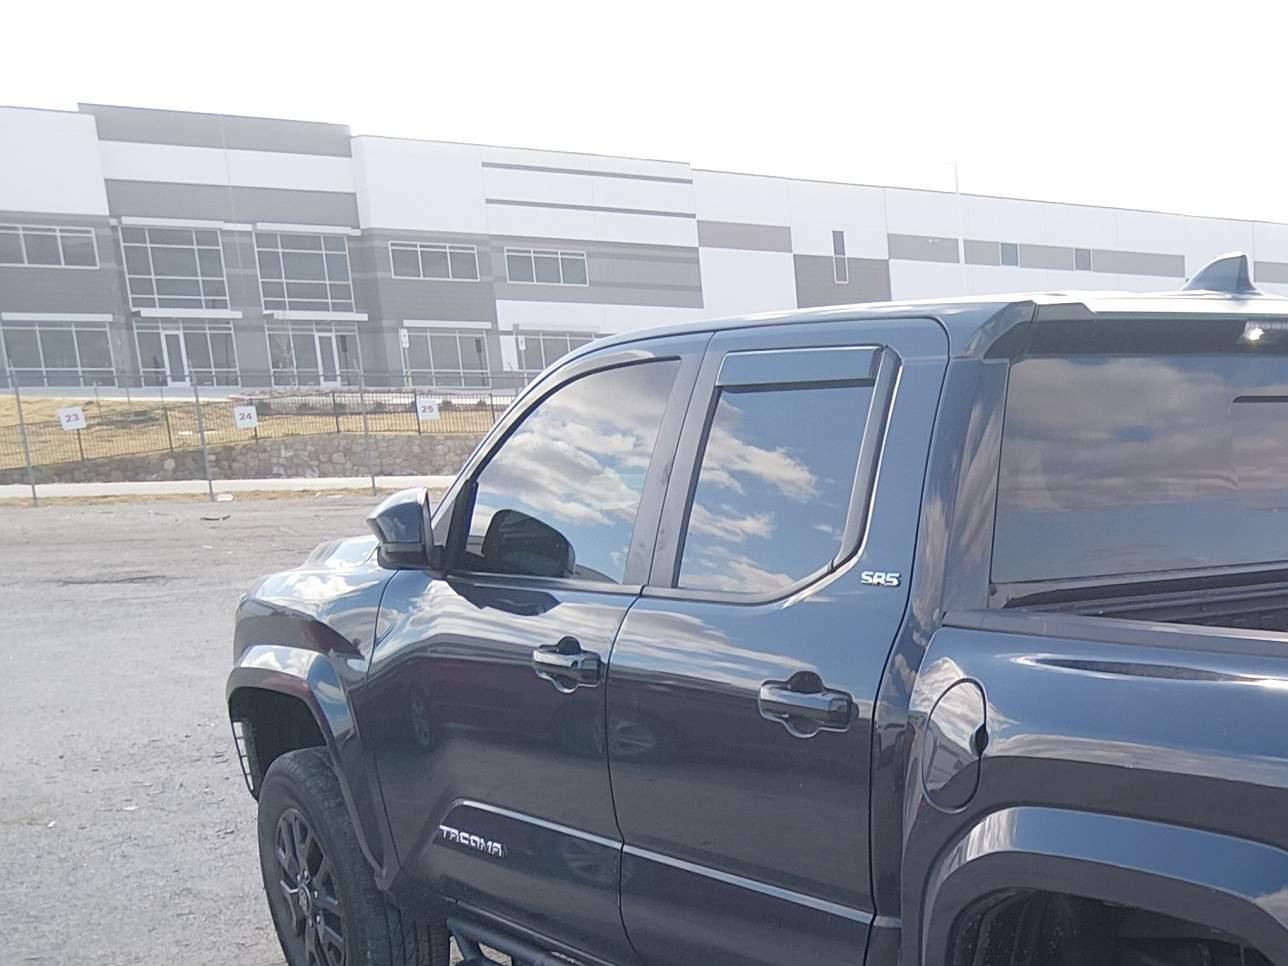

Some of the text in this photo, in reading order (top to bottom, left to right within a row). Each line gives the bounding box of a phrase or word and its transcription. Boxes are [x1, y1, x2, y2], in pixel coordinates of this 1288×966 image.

[64, 413, 80, 423] 23
[239, 412, 253, 421] 24
[860, 570, 901, 586] SR5
[438, 824, 504, 857] TACOMA
